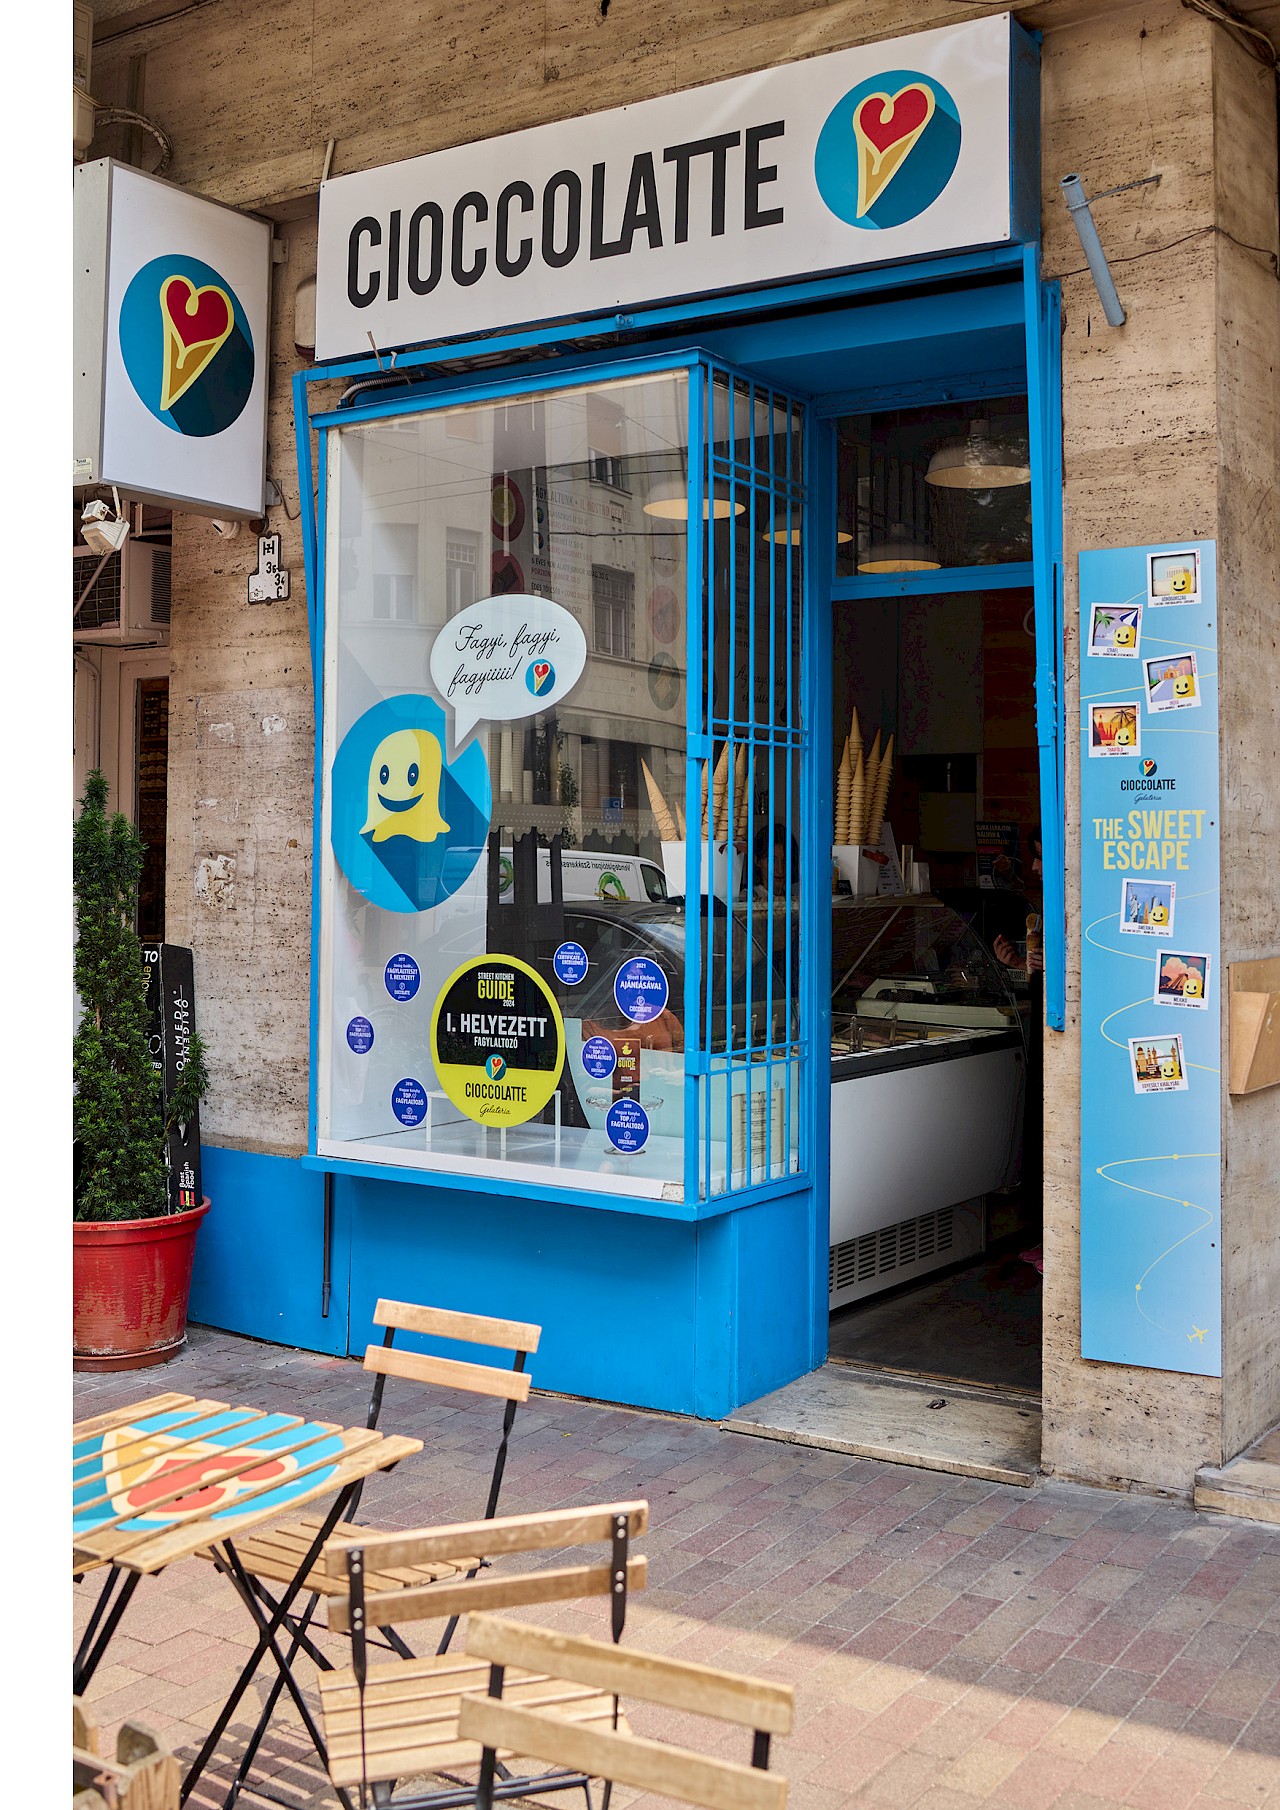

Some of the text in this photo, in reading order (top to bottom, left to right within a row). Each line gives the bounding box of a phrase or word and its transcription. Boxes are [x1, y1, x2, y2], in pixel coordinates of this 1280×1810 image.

[347, 120, 785, 309] CIOCCOLATTE
[455, 623, 561, 660] Fagyi, fagyi,
[1120, 779, 1176, 791] CIOCCOLATTE
[1134, 793, 1162, 805] Gelateria
[1092, 810, 1206, 840] THE SWEET
[1104, 840, 1190, 870] ESCAPE
[144, 950, 158, 962] TO
[478, 972, 514, 980] STREET KITCHEN
[477, 980, 515, 1000] GUIDE
[620, 980, 662, 990] AJÁNLÁSÁVAL
[446, 1012, 547, 1038] I. HELYEZETT
[174, 998, 185, 1072] OLMEDA
[474, 1036, 518, 1049] FAGYLALTOZÓ
[618, 1060, 636, 1068] GUIDE
[465, 1082, 527, 1102] CIOCCOLATTE
[480, 1103, 511, 1117] Gelateria
[611, 1120, 644, 1130] FAGYLALTOZÓ
